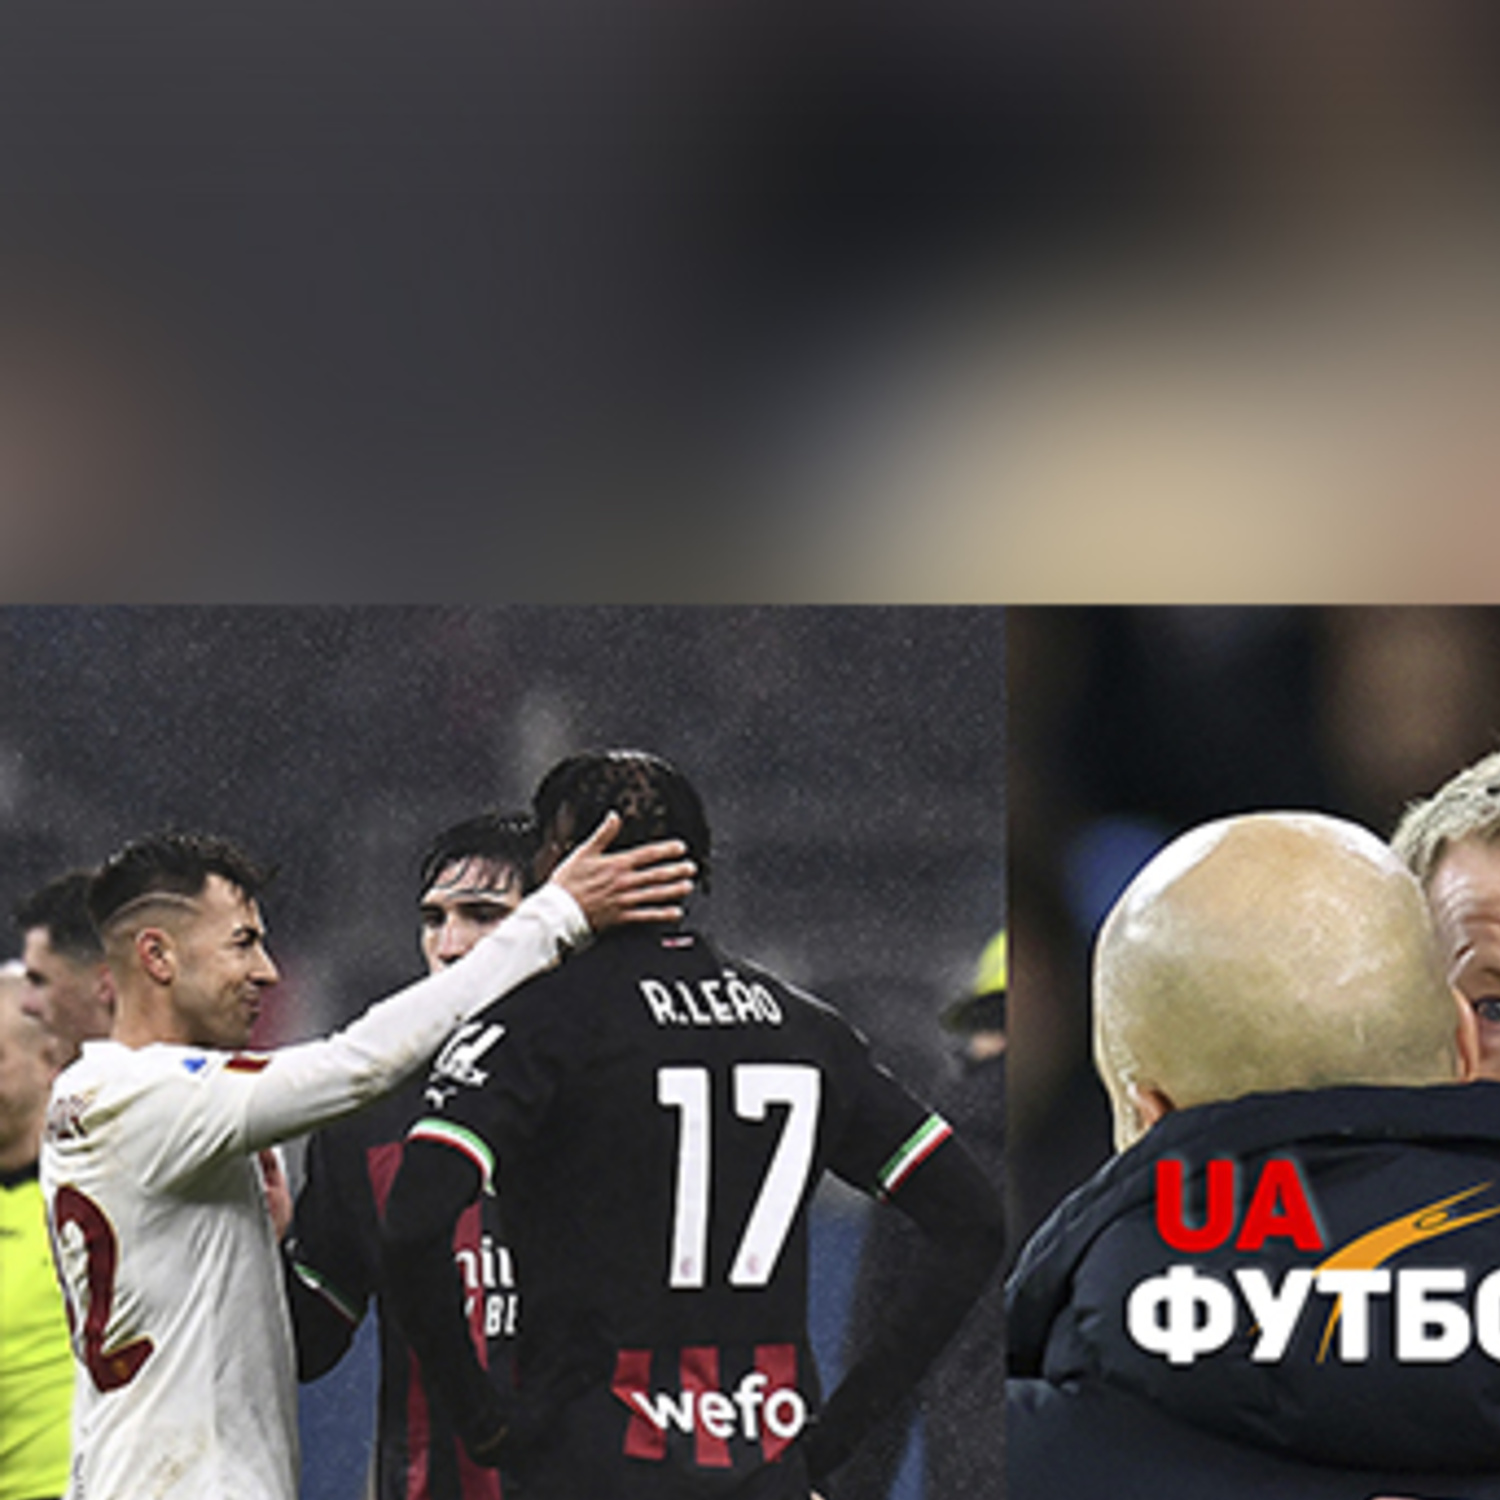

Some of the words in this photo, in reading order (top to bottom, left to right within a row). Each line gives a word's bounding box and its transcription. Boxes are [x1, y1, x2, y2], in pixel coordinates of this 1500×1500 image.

[657, 1064, 821, 1288] 17
[50, 1183, 156, 1393] 2
[629, 1372, 808, 1440] wefo
